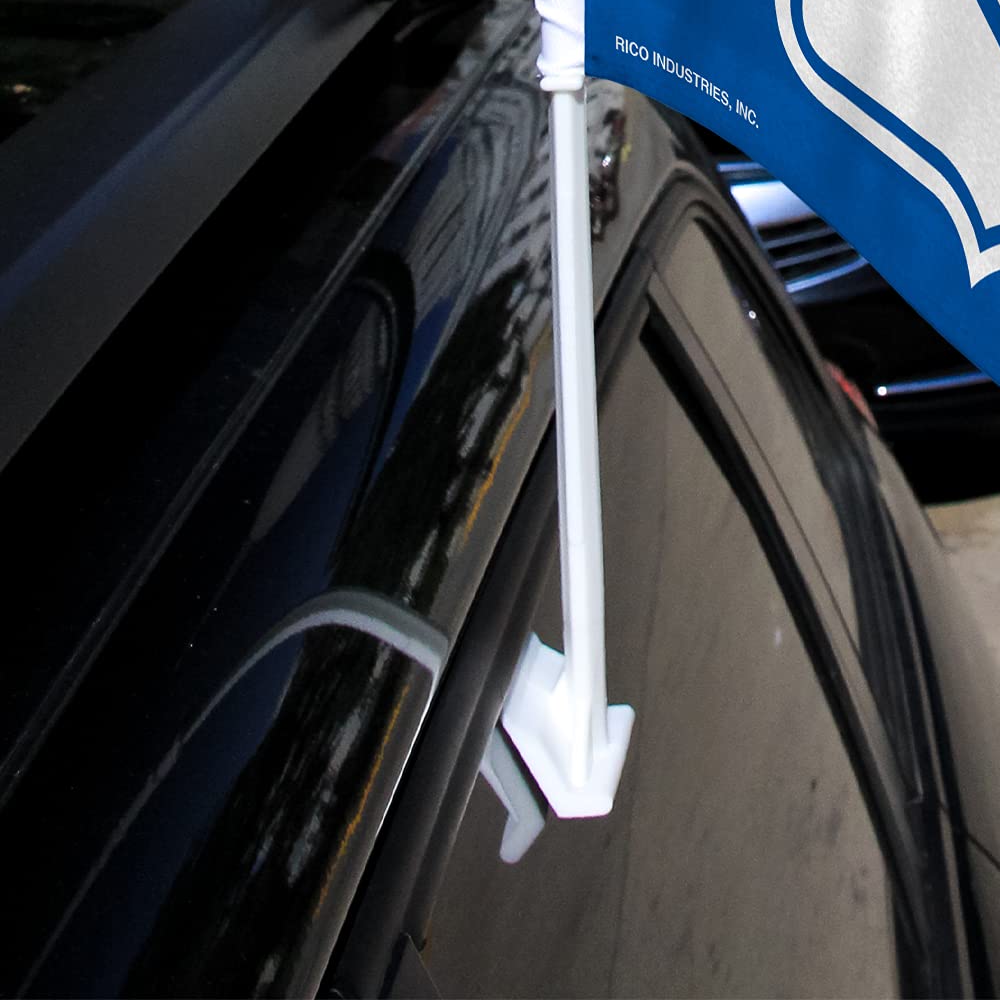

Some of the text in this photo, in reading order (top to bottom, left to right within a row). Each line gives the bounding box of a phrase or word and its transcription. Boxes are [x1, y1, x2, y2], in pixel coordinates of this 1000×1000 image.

[615, 35, 760, 129] RICO INDUSTRIES, INC.
